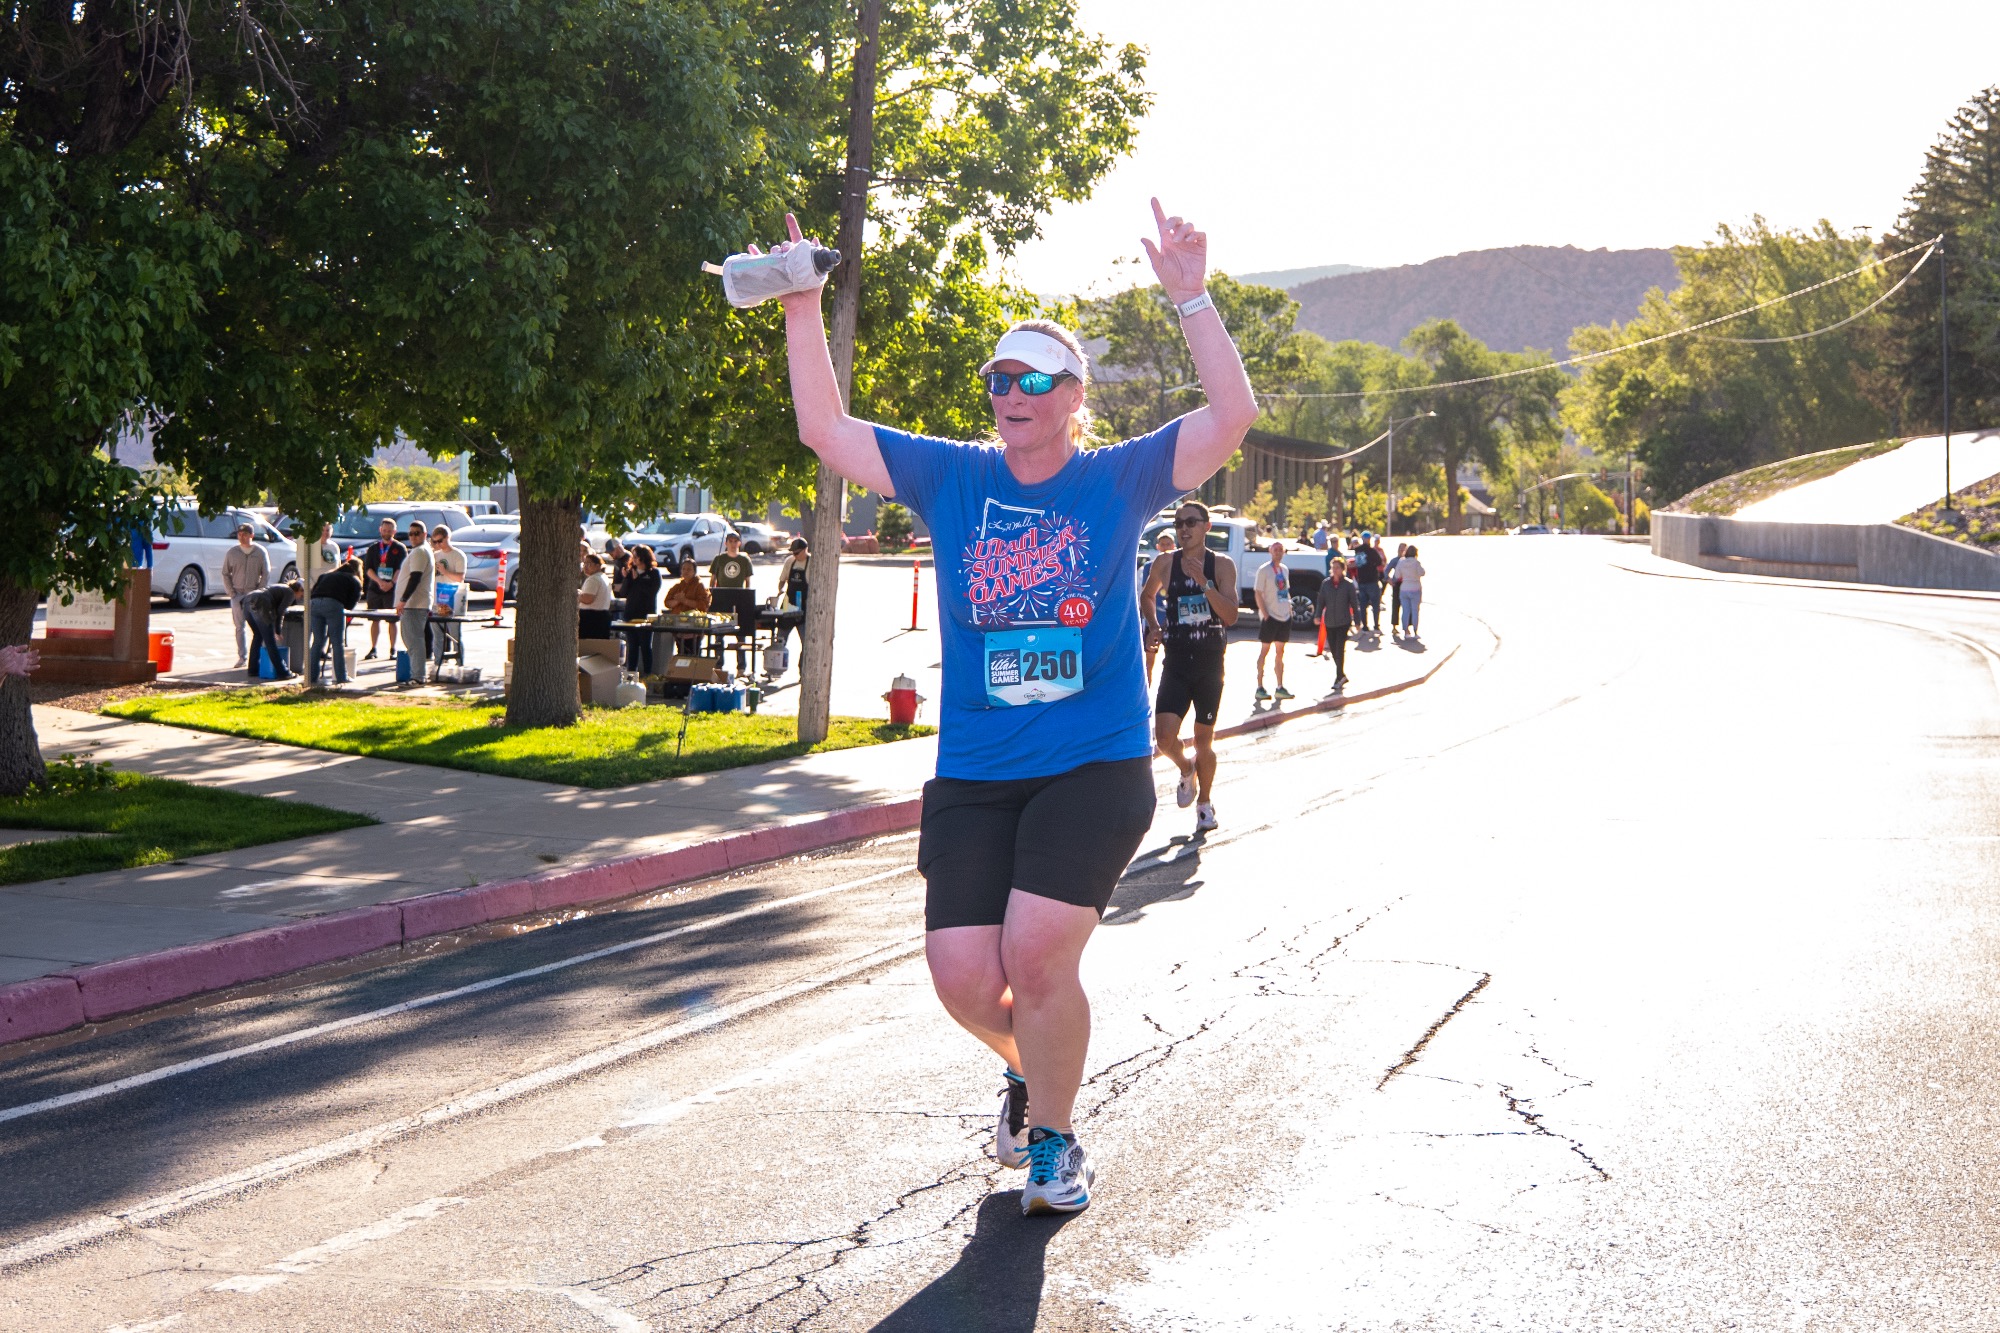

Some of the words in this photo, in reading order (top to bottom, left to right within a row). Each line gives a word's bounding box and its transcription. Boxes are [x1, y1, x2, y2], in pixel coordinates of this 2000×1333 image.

[974, 527, 1039, 560] UTAH
[970, 525, 1076, 583] SUMMER
[969, 555, 1064, 604] GAMES
[1063, 602, 1088, 619] 40
[1190, 602, 1207, 615] 311
[1065, 617, 1090, 626] YEARS
[990, 657, 1018, 671] Utah
[1022, 649, 1077, 681] 250
[991, 669, 1019, 677] SUMMER
[991, 675, 1020, 684] GAMES
